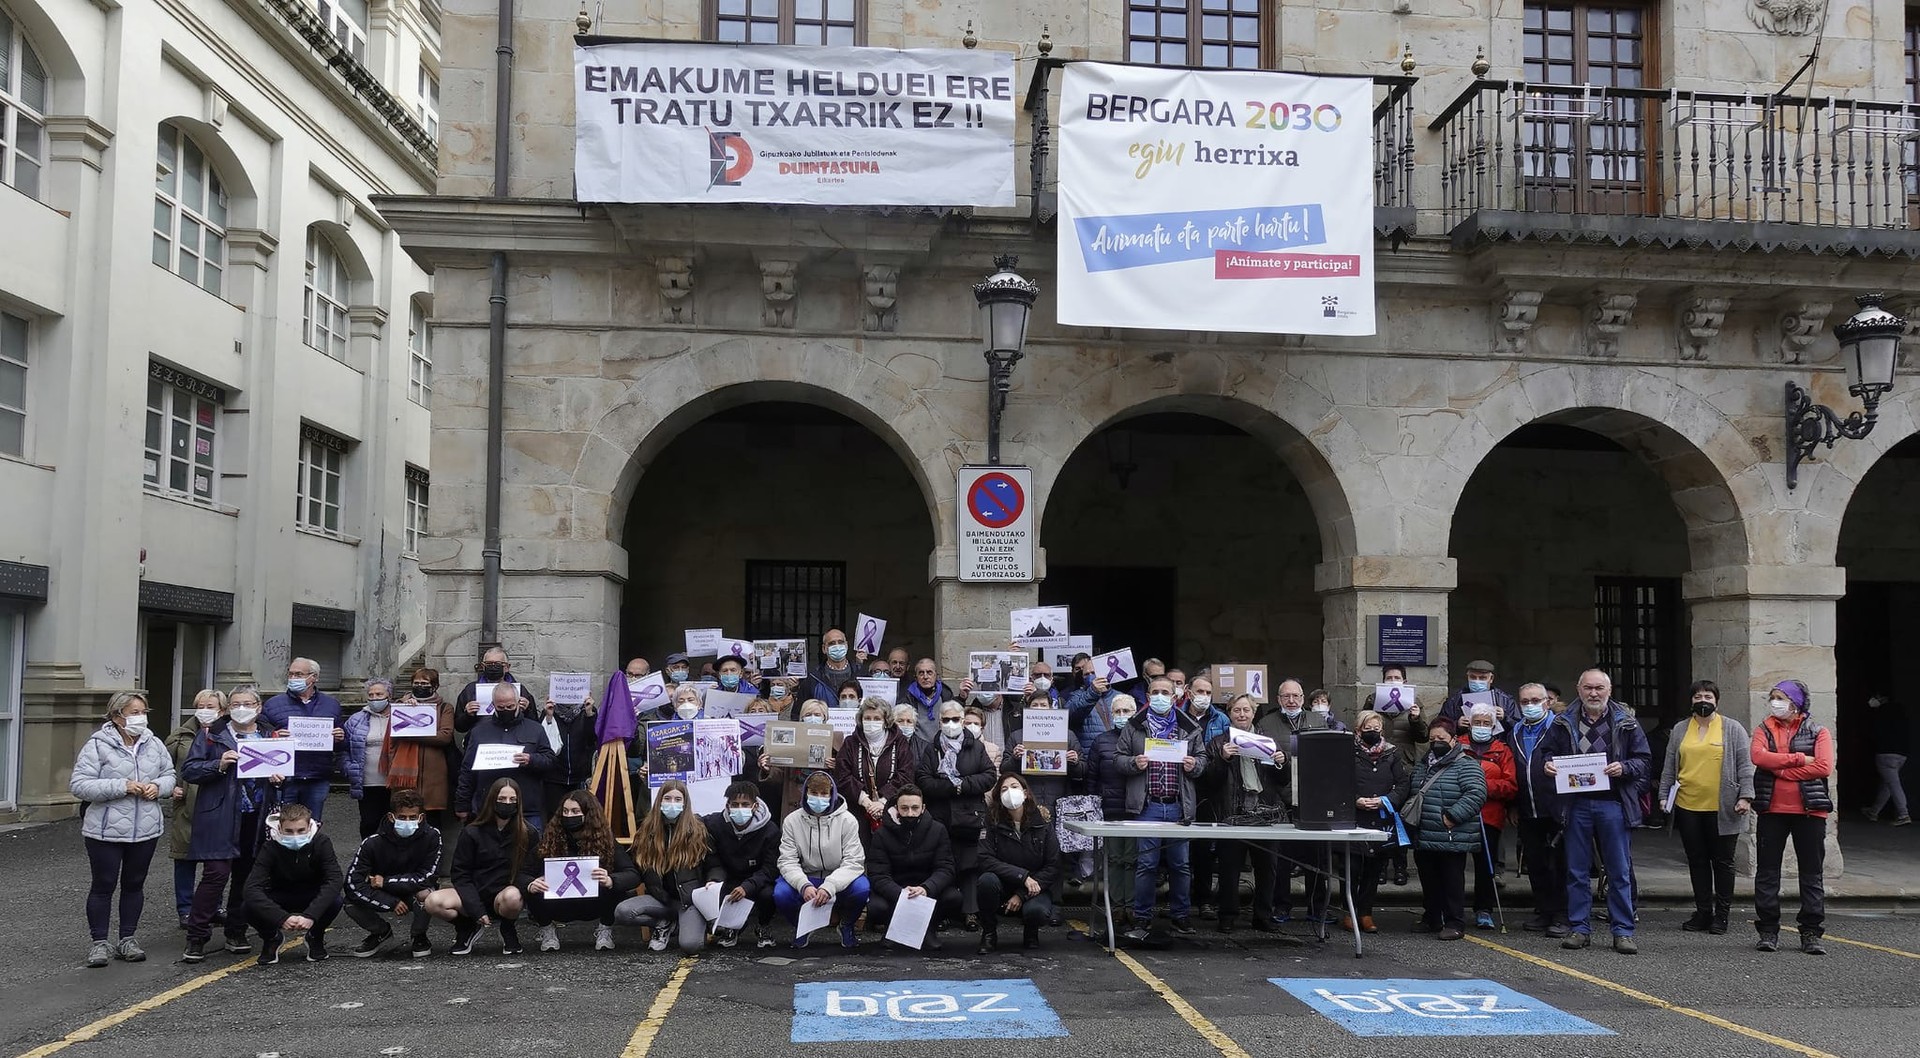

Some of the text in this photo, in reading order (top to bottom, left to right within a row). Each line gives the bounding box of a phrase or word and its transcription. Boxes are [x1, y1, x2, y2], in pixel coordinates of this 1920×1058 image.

[585, 66, 1011, 101] EMAKUME HELDUEI ERE
[610, 98, 984, 128] TRATU TXARRIK EZ !!
[1086, 93, 1342, 133] BERGARA 2030
[760, 150, 802, 158] Gipuzkoako
[778, 161, 880, 175] DUINTASUNA
[1128, 138, 1300, 180] egin herrixa
[1091, 221, 1172, 254] Animatu
[1177, 219, 1201, 251] eta
[1207, 214, 1250, 254] parte
[1226, 255, 1353, 272] ¡Anímate y participa!
